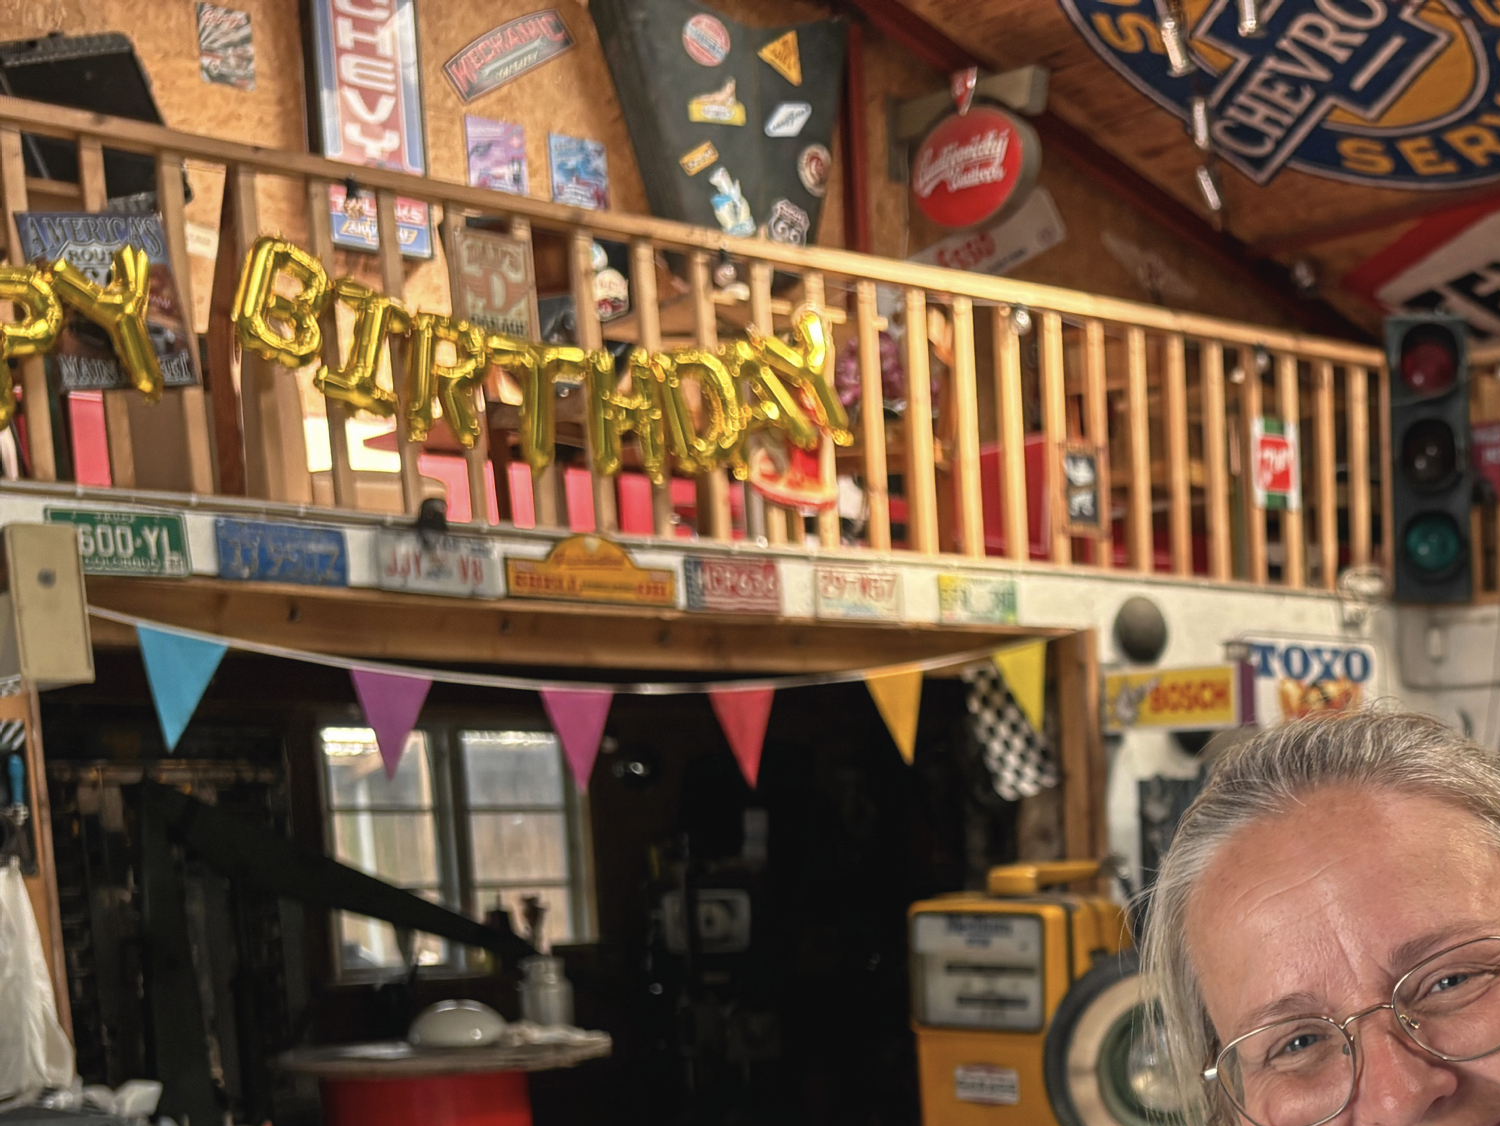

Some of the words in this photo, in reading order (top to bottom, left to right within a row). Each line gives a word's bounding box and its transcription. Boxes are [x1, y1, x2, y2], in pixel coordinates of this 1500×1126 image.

[334, 0, 400, 159] CHEVY
[452, 14, 568, 91] MECHANIC
[230, 233, 853, 484] BIRTHDAY
[1149, 681, 1230, 713] BOSCH
